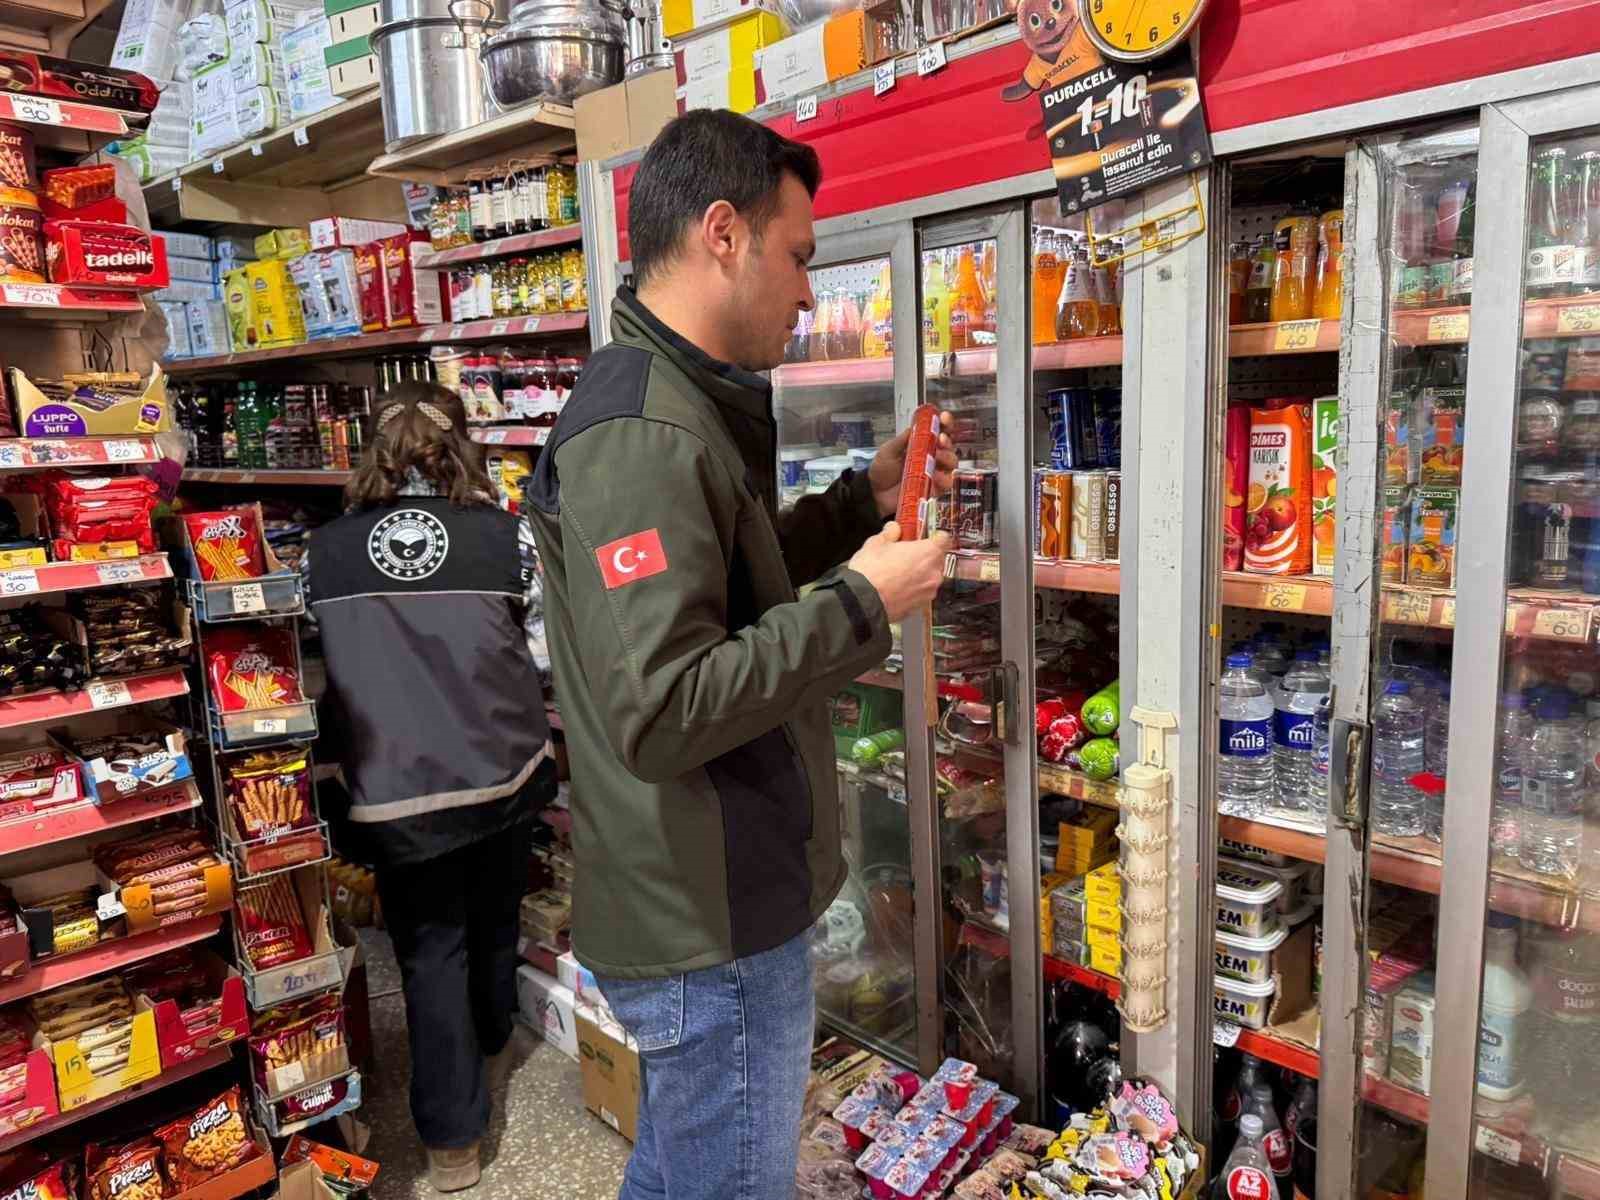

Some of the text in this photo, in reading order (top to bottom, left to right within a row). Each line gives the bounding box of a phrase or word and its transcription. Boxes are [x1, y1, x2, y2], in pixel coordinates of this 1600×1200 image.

[1172, 12, 1181, 25] 5
[1105, 22, 1113, 34] 8
[1148, 26, 1159, 42] 6
[1124, 33, 1132, 45] 7
[1043, 66, 1117, 108] DURACELL
[22, 106, 50, 121] 90
[1100, 137, 1144, 165] Duracell
[1102, 155, 1145, 178] tasarruf
[1148, 142, 1173, 160] edin
[85, 251, 154, 267] tadelle
[31, 413, 78, 423] LUPPO
[114, 450, 130, 458] 20
[1107, 483, 1117, 532] OBSESSO
[1553, 623, 1580, 636] 60
[1229, 735, 1265, 748] mila
[1288, 728, 1314, 743] mil
[64, 1056, 82, 1076] 15
[189, 1101, 229, 1138] Pizza
[109, 1160, 152, 1195] Pizza
[1236, 1174, 1261, 1189] AZ
